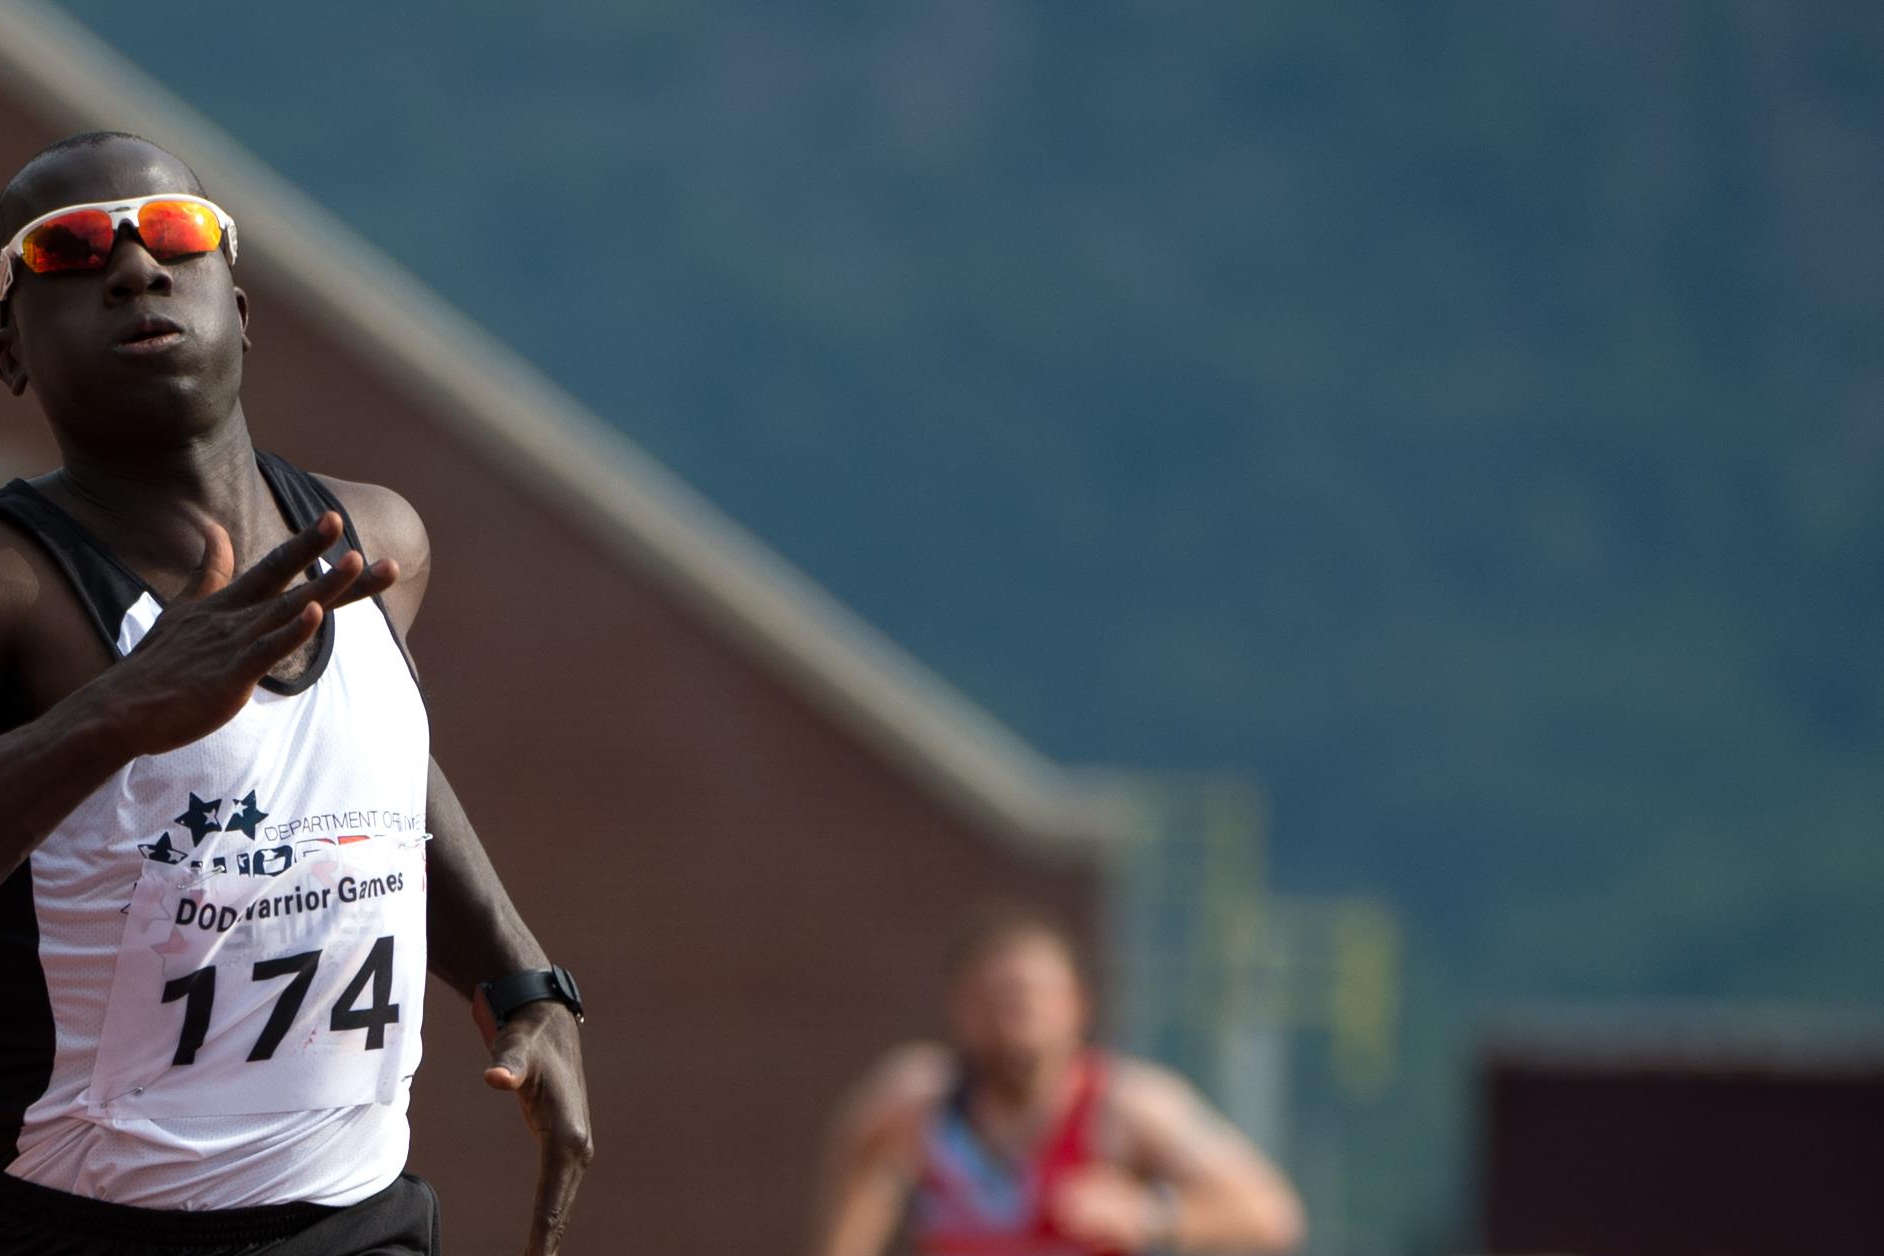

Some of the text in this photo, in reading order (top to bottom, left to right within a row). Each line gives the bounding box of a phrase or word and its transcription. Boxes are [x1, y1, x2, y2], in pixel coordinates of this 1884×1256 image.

[264, 810, 378, 842] DEPARTMENT
[382, 810, 401, 830] OF
[175, 898, 238, 933] DOD
[338, 871, 404, 903] Games
[161, 935, 399, 1066] 174
